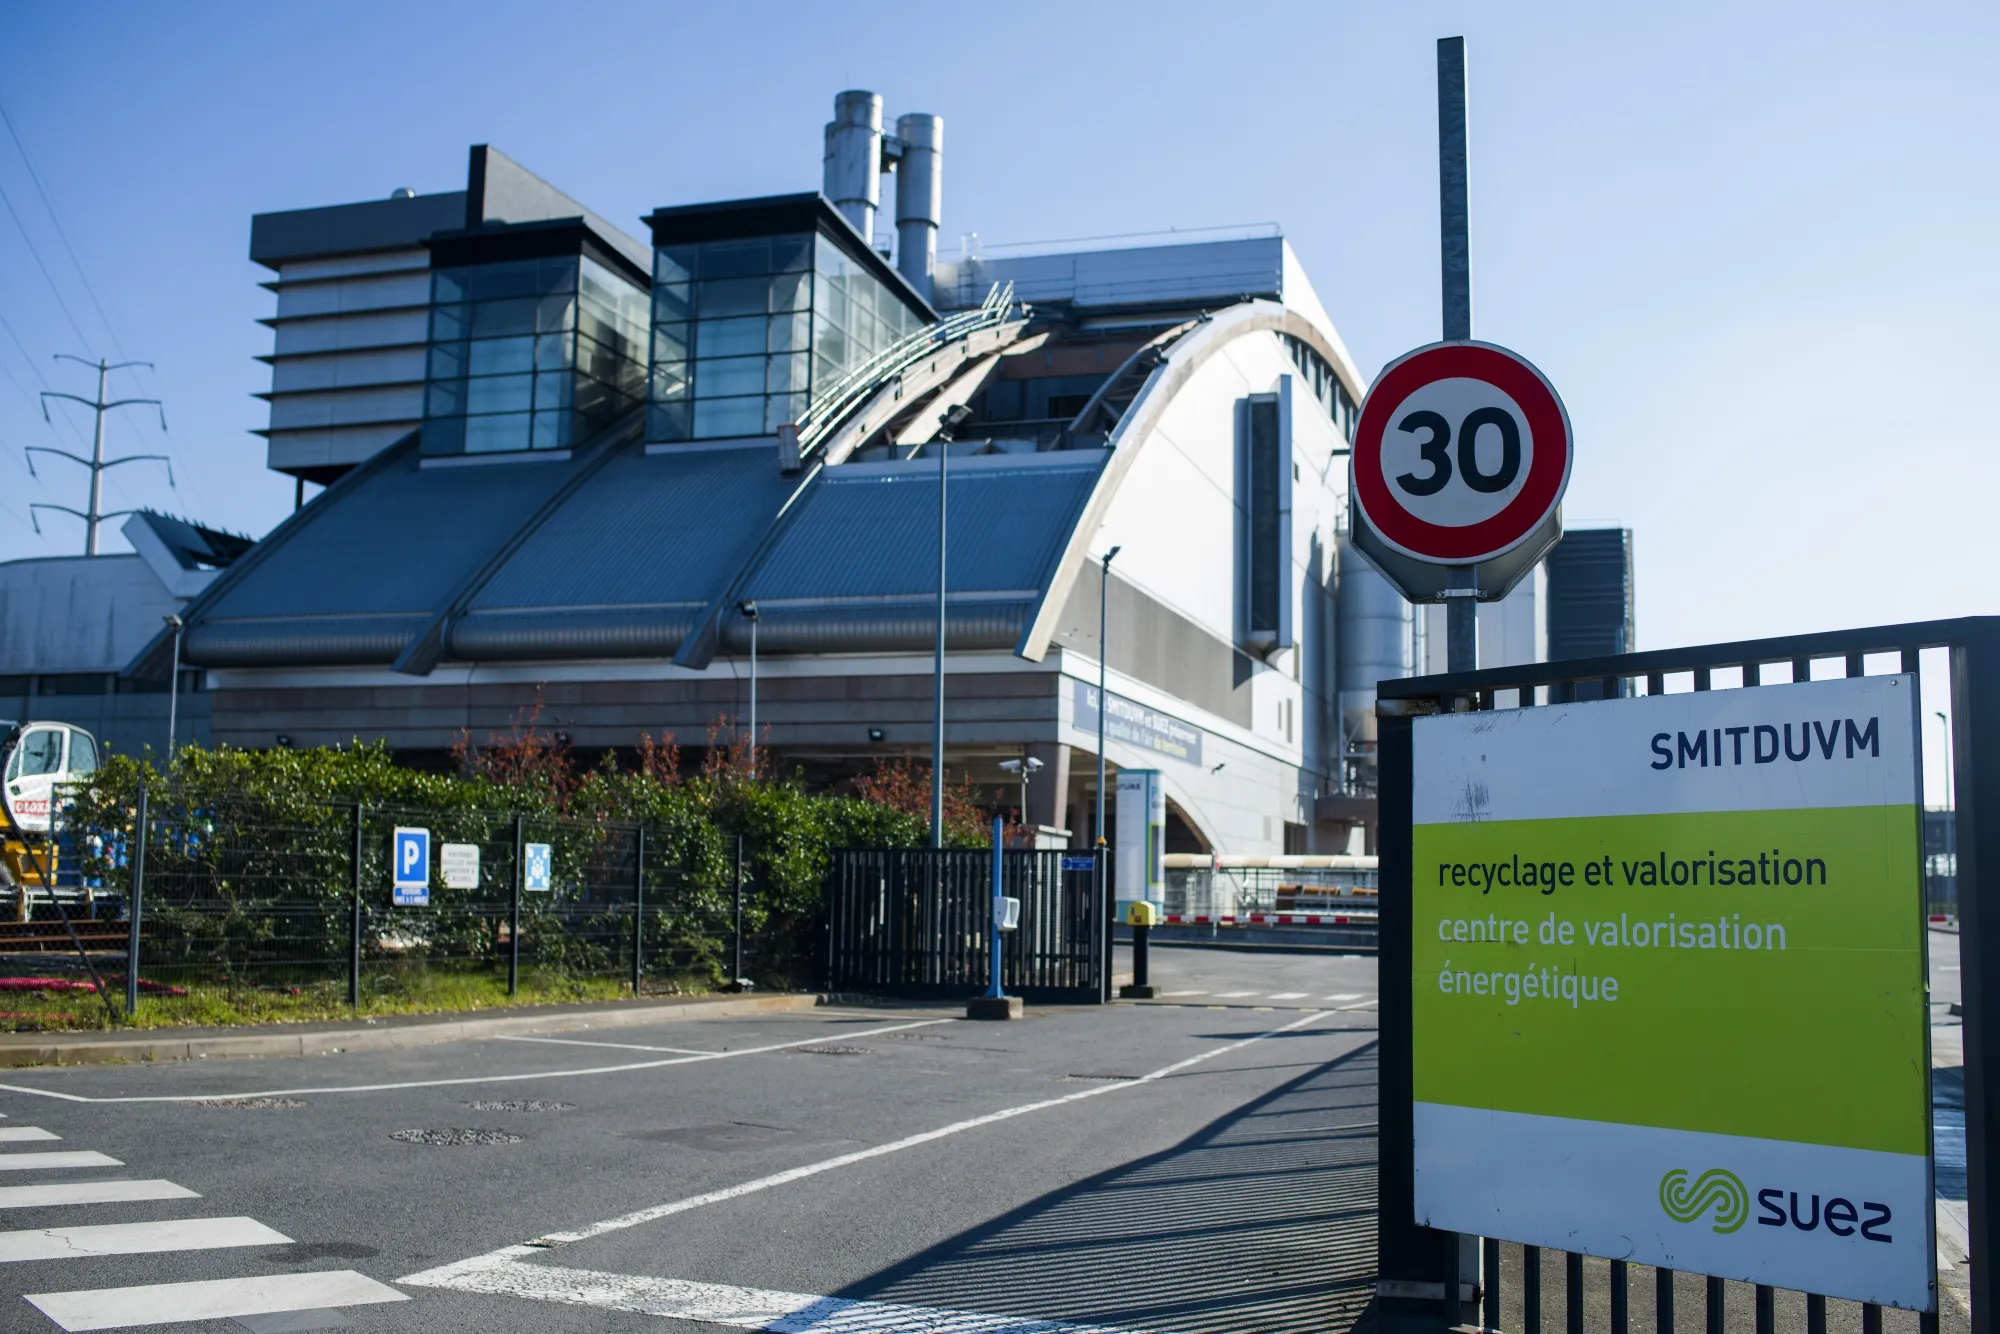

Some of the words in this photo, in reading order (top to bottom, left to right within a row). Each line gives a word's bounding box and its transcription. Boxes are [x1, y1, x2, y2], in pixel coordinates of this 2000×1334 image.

[1396, 407, 1521, 496] 30
[1152, 714, 1169, 734] SUEZ
[1650, 717, 1880, 770] SMITDUVM
[404, 840, 420, 875] P
[1439, 854, 1575, 895] recyclage
[1584, 855, 1613, 886] et
[1622, 849, 1827, 886] valorisation
[1438, 914, 1529, 945] centre
[1539, 912, 1575, 946] de
[1583, 912, 1787, 950] valorisation
[1438, 960, 1619, 1009] énergétique
